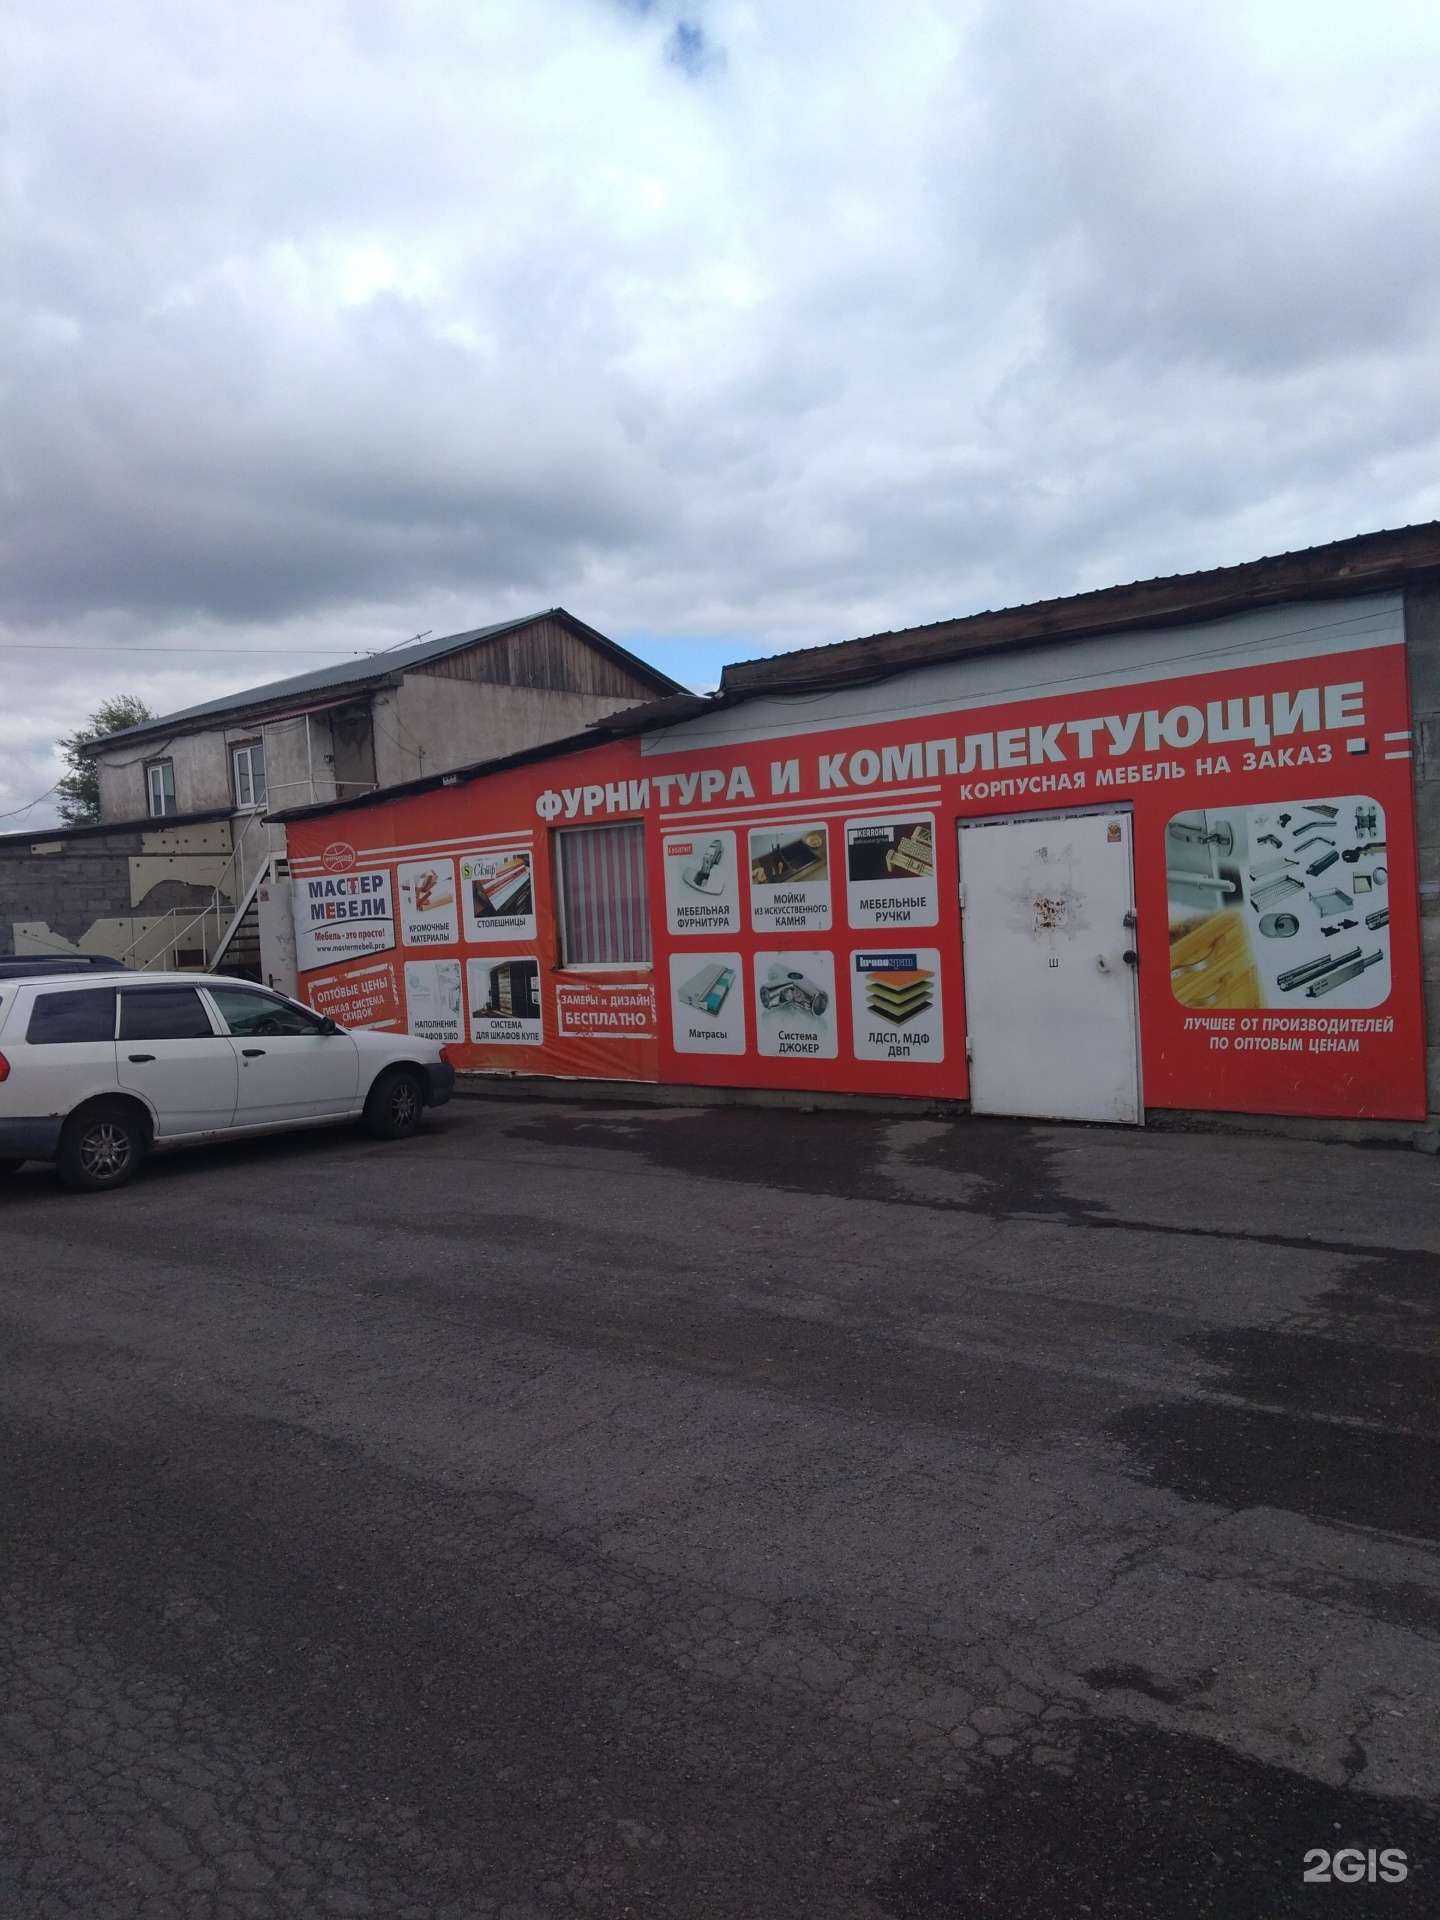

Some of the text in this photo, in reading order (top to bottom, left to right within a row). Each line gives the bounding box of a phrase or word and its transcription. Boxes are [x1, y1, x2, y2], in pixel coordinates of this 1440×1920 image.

[535, 680, 1365, 822] ФУРНИТУРА И КОМПЛЕКТУЮЩИЕ
[960, 744, 1333, 801] КОРПУСНАЯ МЕБЕЛЬ НА ЗАКАЗ
[308, 875, 384, 898] МАСТЕР
[773, 892, 806, 904] МОЙКИ
[860, 896, 927, 910] МЕБЕЛЬНЫЕ
[310, 898, 386, 920] МЕБЕЛИ
[677, 905, 730, 917] МЕБЕЛЬНАЯ
[754, 905, 828, 915] ИЗ ИСКУССТВЕННОГО
[775, 916, 806, 926] КАМНЯ
[875, 910, 911, 922] РУЧКИ
[409, 922, 450, 933] КРОМОЧНЫЕ
[477, 918, 526, 929] СТОЛЕШНИЦЫ
[677, 917, 730, 928] ФУРНИТУРА
[314, 931, 341, 941] Мебель
[345, 931, 357, 939] это
[358, 928, 385, 940] просто!
[410, 933, 450, 943] МАТЕРИАЛЫ
[317, 976, 388, 1003] ОПТОВЫЕ ЦЕНЫ
[352, 994, 385, 1010] СИСТЕМА
[561, 995, 599, 1006] ЗАМЕРЫ
[610, 994, 650, 1008] ДИЗАЙН
[342, 1007, 373, 1022] СКИДОК
[565, 1012, 646, 1026] БЕСПЛАТНО
[414, 1020, 457, 1029] НАПОЛНЕНИЕ
[490, 1020, 523, 1029] СИСТЕМА
[1184, 1016, 1394, 1035] ЛУЧШЕЕ ОТ ПРОИЗВОДИТЕЛЕЙ
[476, 1032, 540, 1041] ДЛЯ ШКАФОВ КУПЕ
[689, 1029, 727, 1039] Матрасы
[778, 1031, 818, 1041] Система
[868, 1032, 930, 1046] ЛДСП, МДФ
[778, 1043, 820, 1053] ДЖОКЕР
[1209, 1036, 1360, 1054] ПО ОПТОВЫМ ЦЕНАМ
[888, 1046, 911, 1057] ДВП
